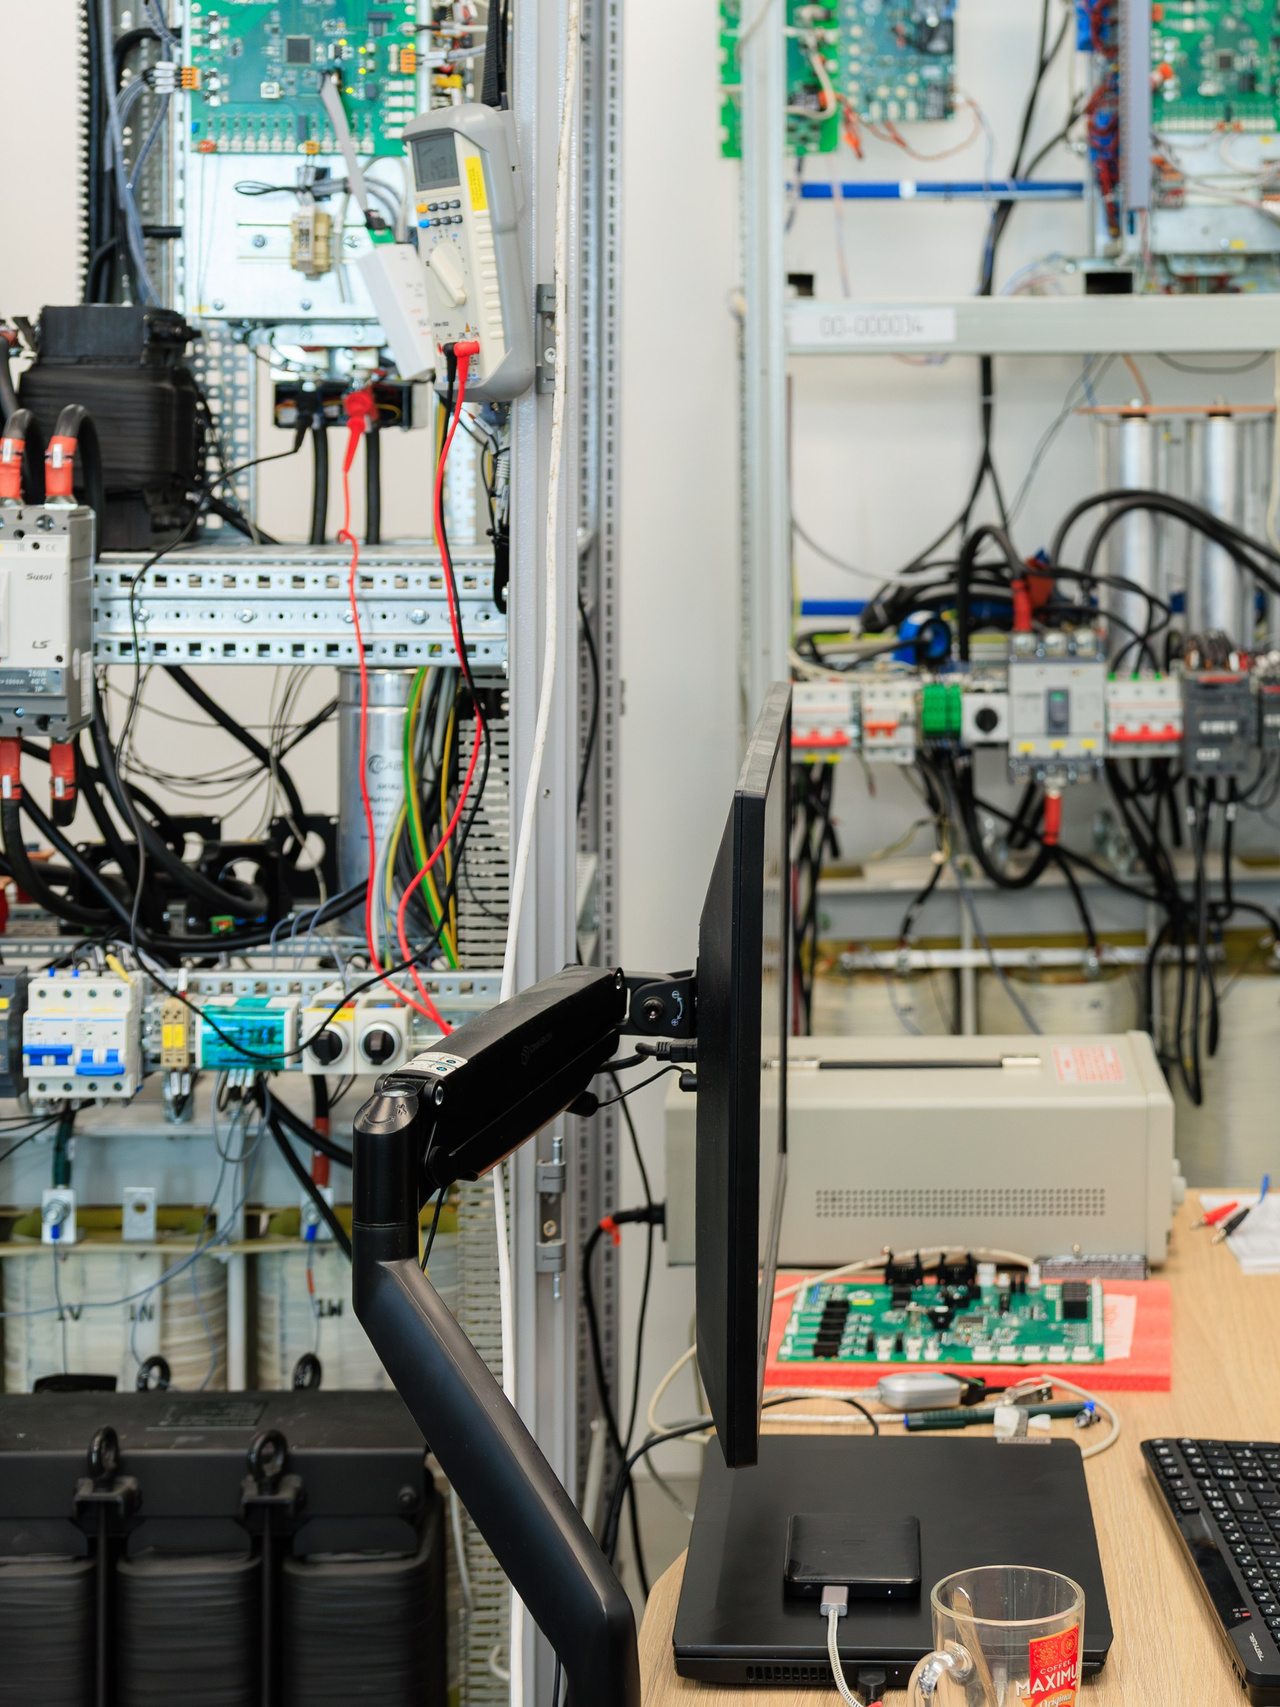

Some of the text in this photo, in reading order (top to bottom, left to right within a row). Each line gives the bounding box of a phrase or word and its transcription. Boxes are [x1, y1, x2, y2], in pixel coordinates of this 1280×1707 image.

[32, 639, 51, 649] LS
[1040, 1659, 1072, 1675] COFFEE
[1015, 1661, 1080, 1697] MAXIMU
